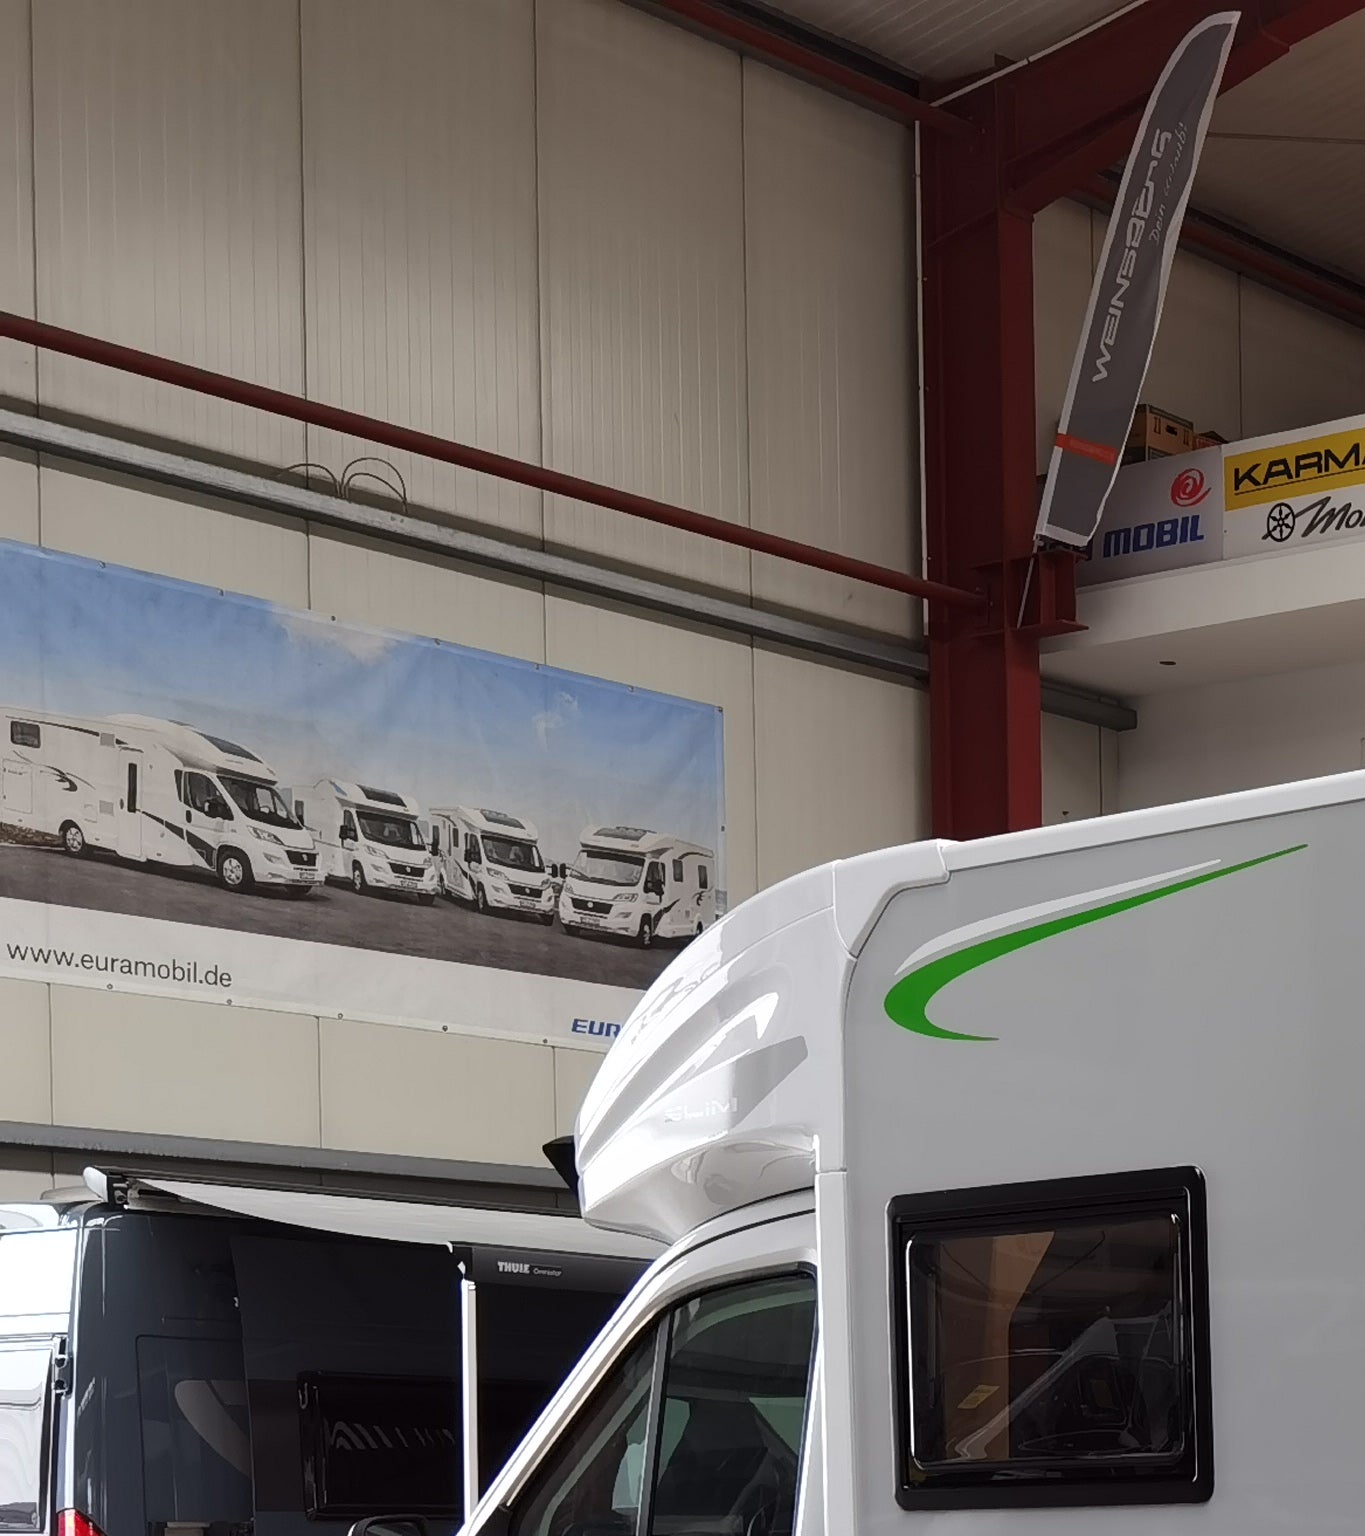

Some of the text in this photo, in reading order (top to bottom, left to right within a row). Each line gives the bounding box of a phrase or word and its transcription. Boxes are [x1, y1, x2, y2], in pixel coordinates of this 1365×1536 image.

[1102, 514, 1205, 559] MOBIL
[6, 939, 232, 989] www.euramobil.de
[571, 1018, 624, 1038] EUR
[497, 1261, 530, 1274] THULE
